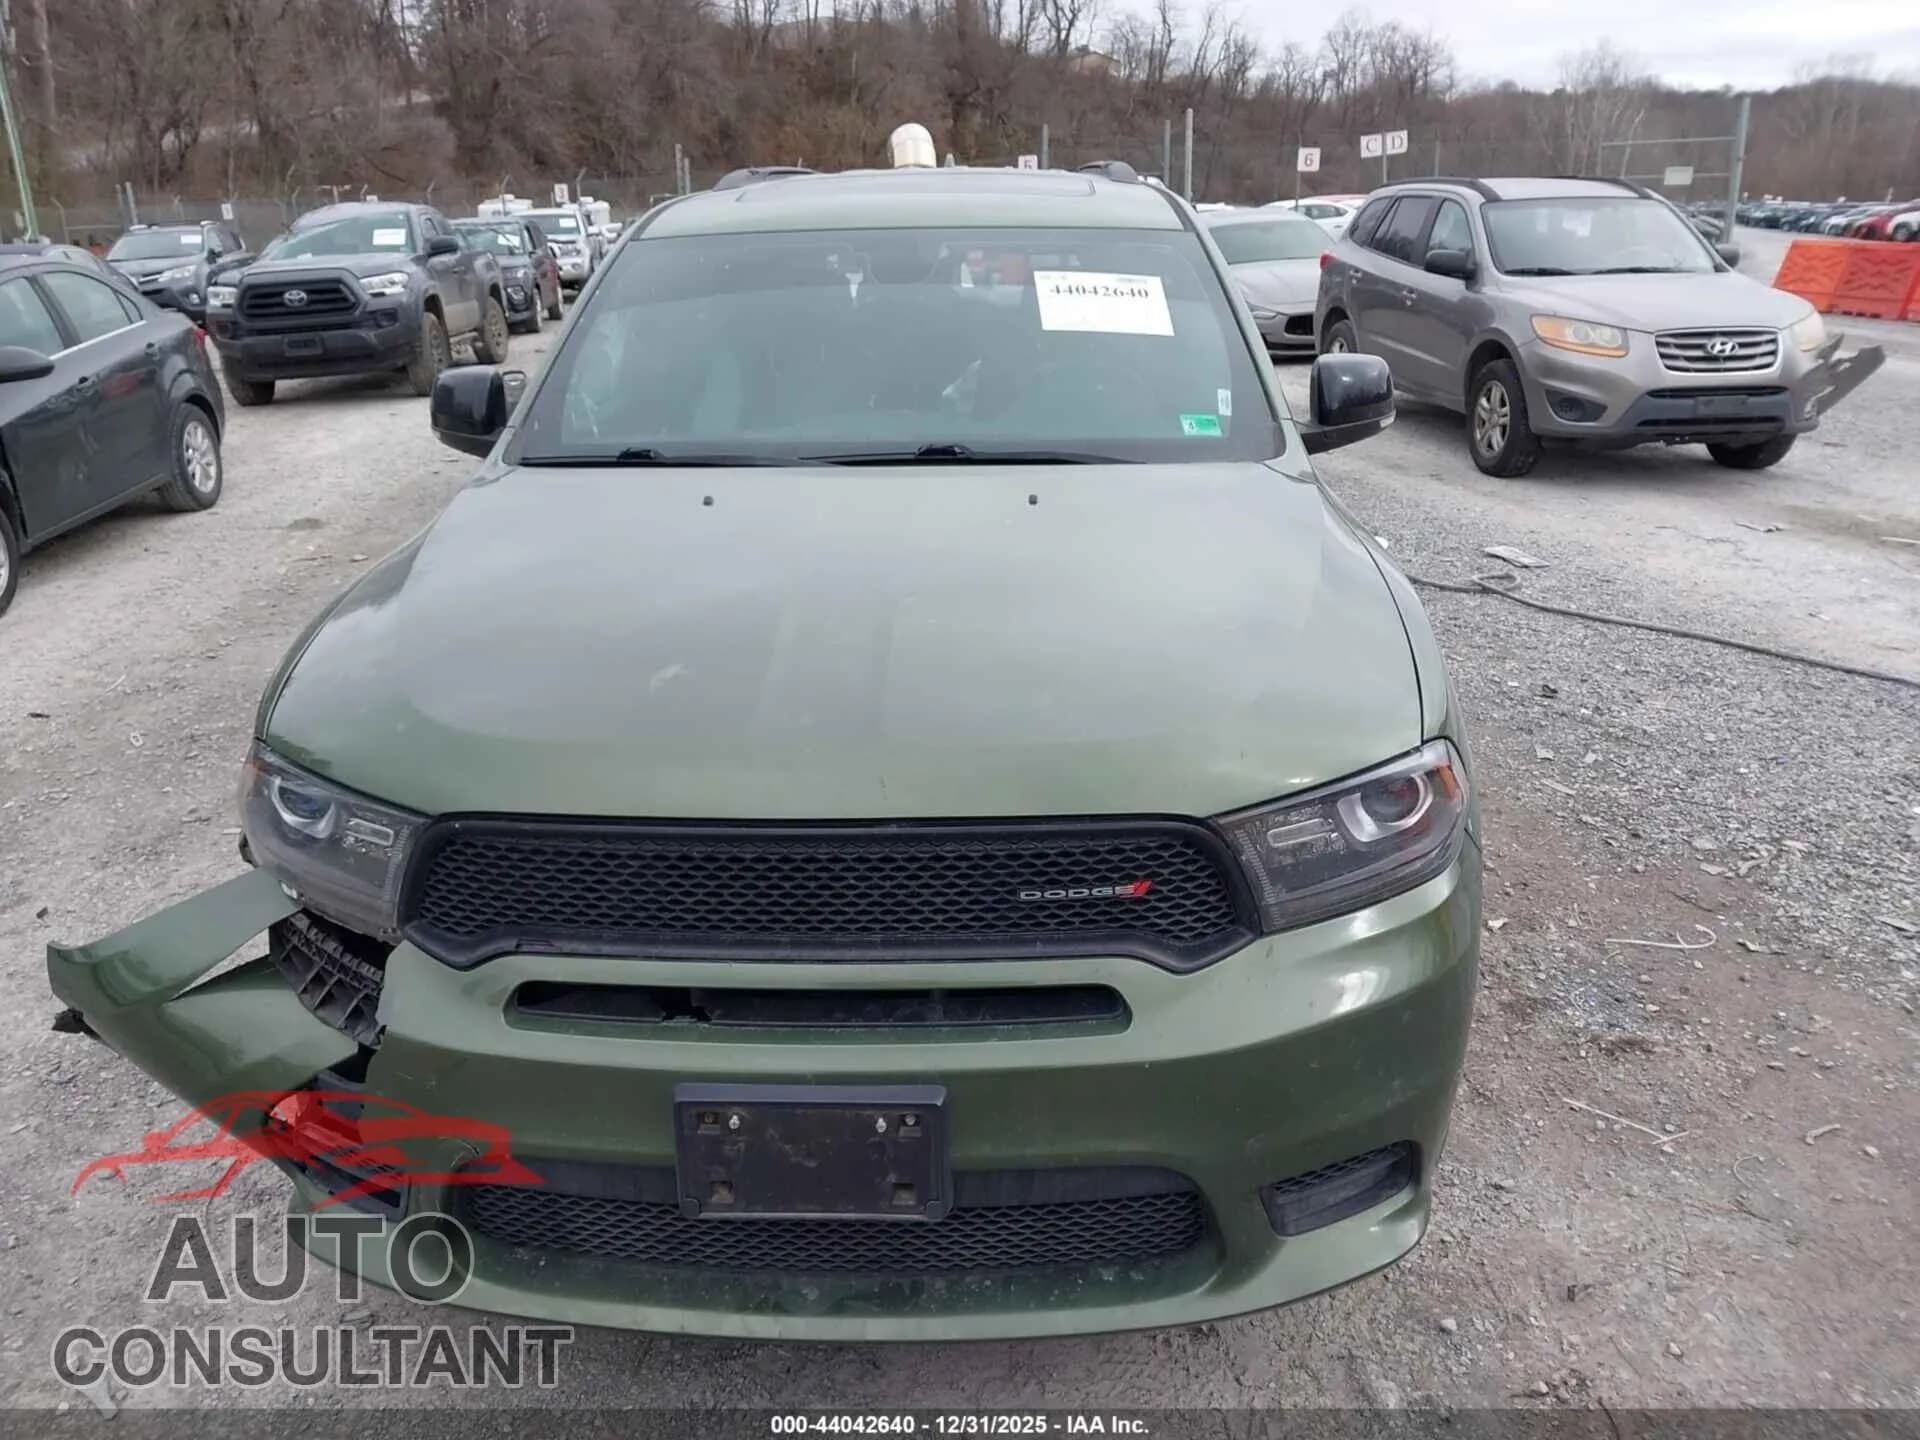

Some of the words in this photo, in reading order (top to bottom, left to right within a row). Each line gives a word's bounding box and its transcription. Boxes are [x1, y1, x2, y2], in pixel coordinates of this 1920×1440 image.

[1366, 138, 1378, 153] C
[1391, 135, 1404, 150] D
[1304, 152, 1314, 167] 6
[1049, 284, 1149, 299] 44042640
[1020, 885, 1135, 899] DODGE
